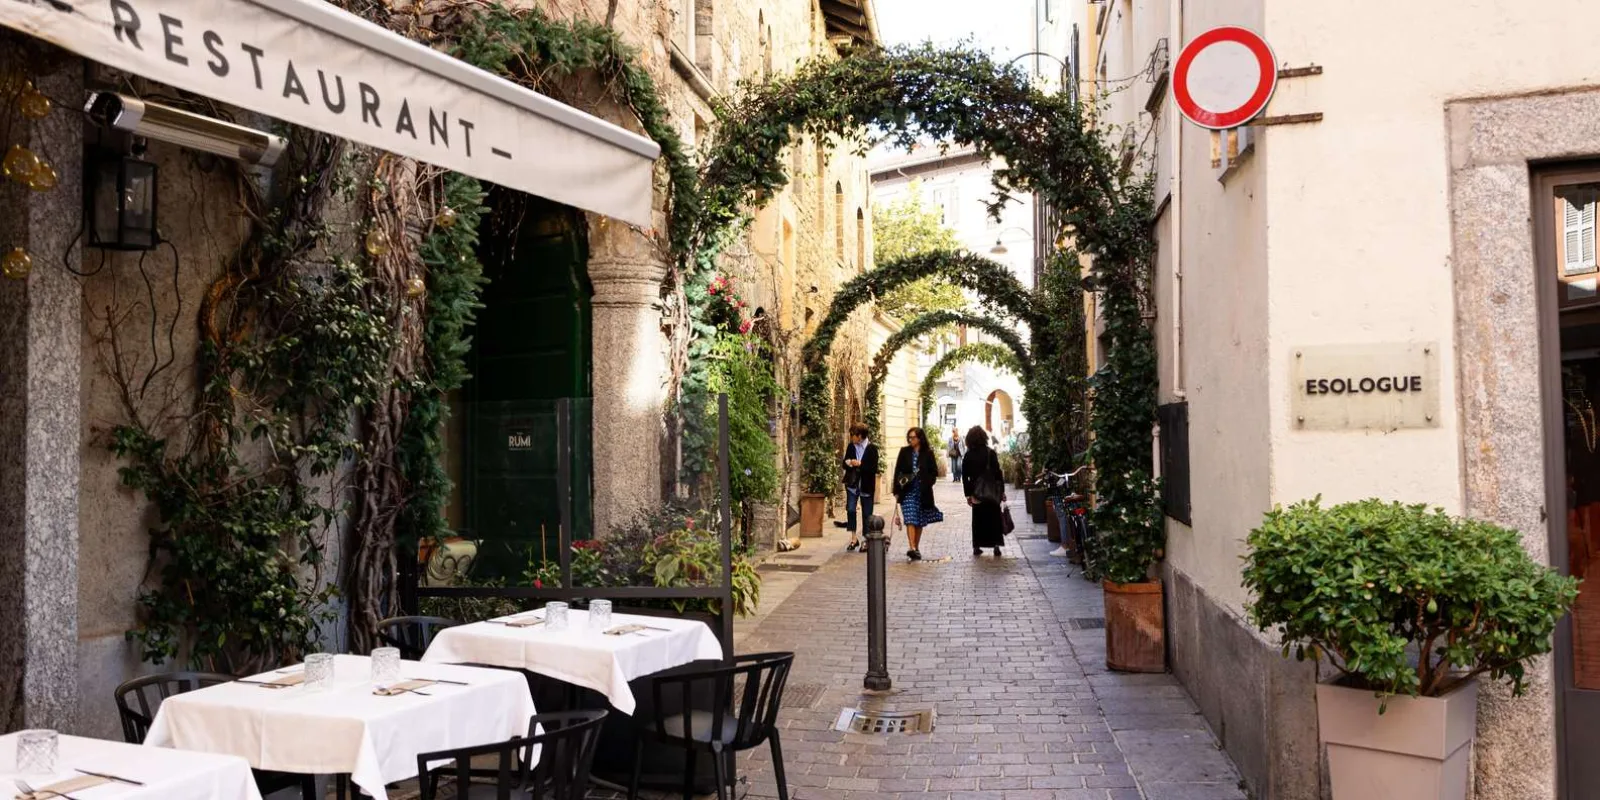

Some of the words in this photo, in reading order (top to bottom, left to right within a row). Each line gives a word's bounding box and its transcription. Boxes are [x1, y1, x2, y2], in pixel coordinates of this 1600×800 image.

[109, 0, 476, 158] RESTAURANT
[1306, 375, 1422, 395] ESOLOGUE
[508, 435, 531, 447] RUMI
